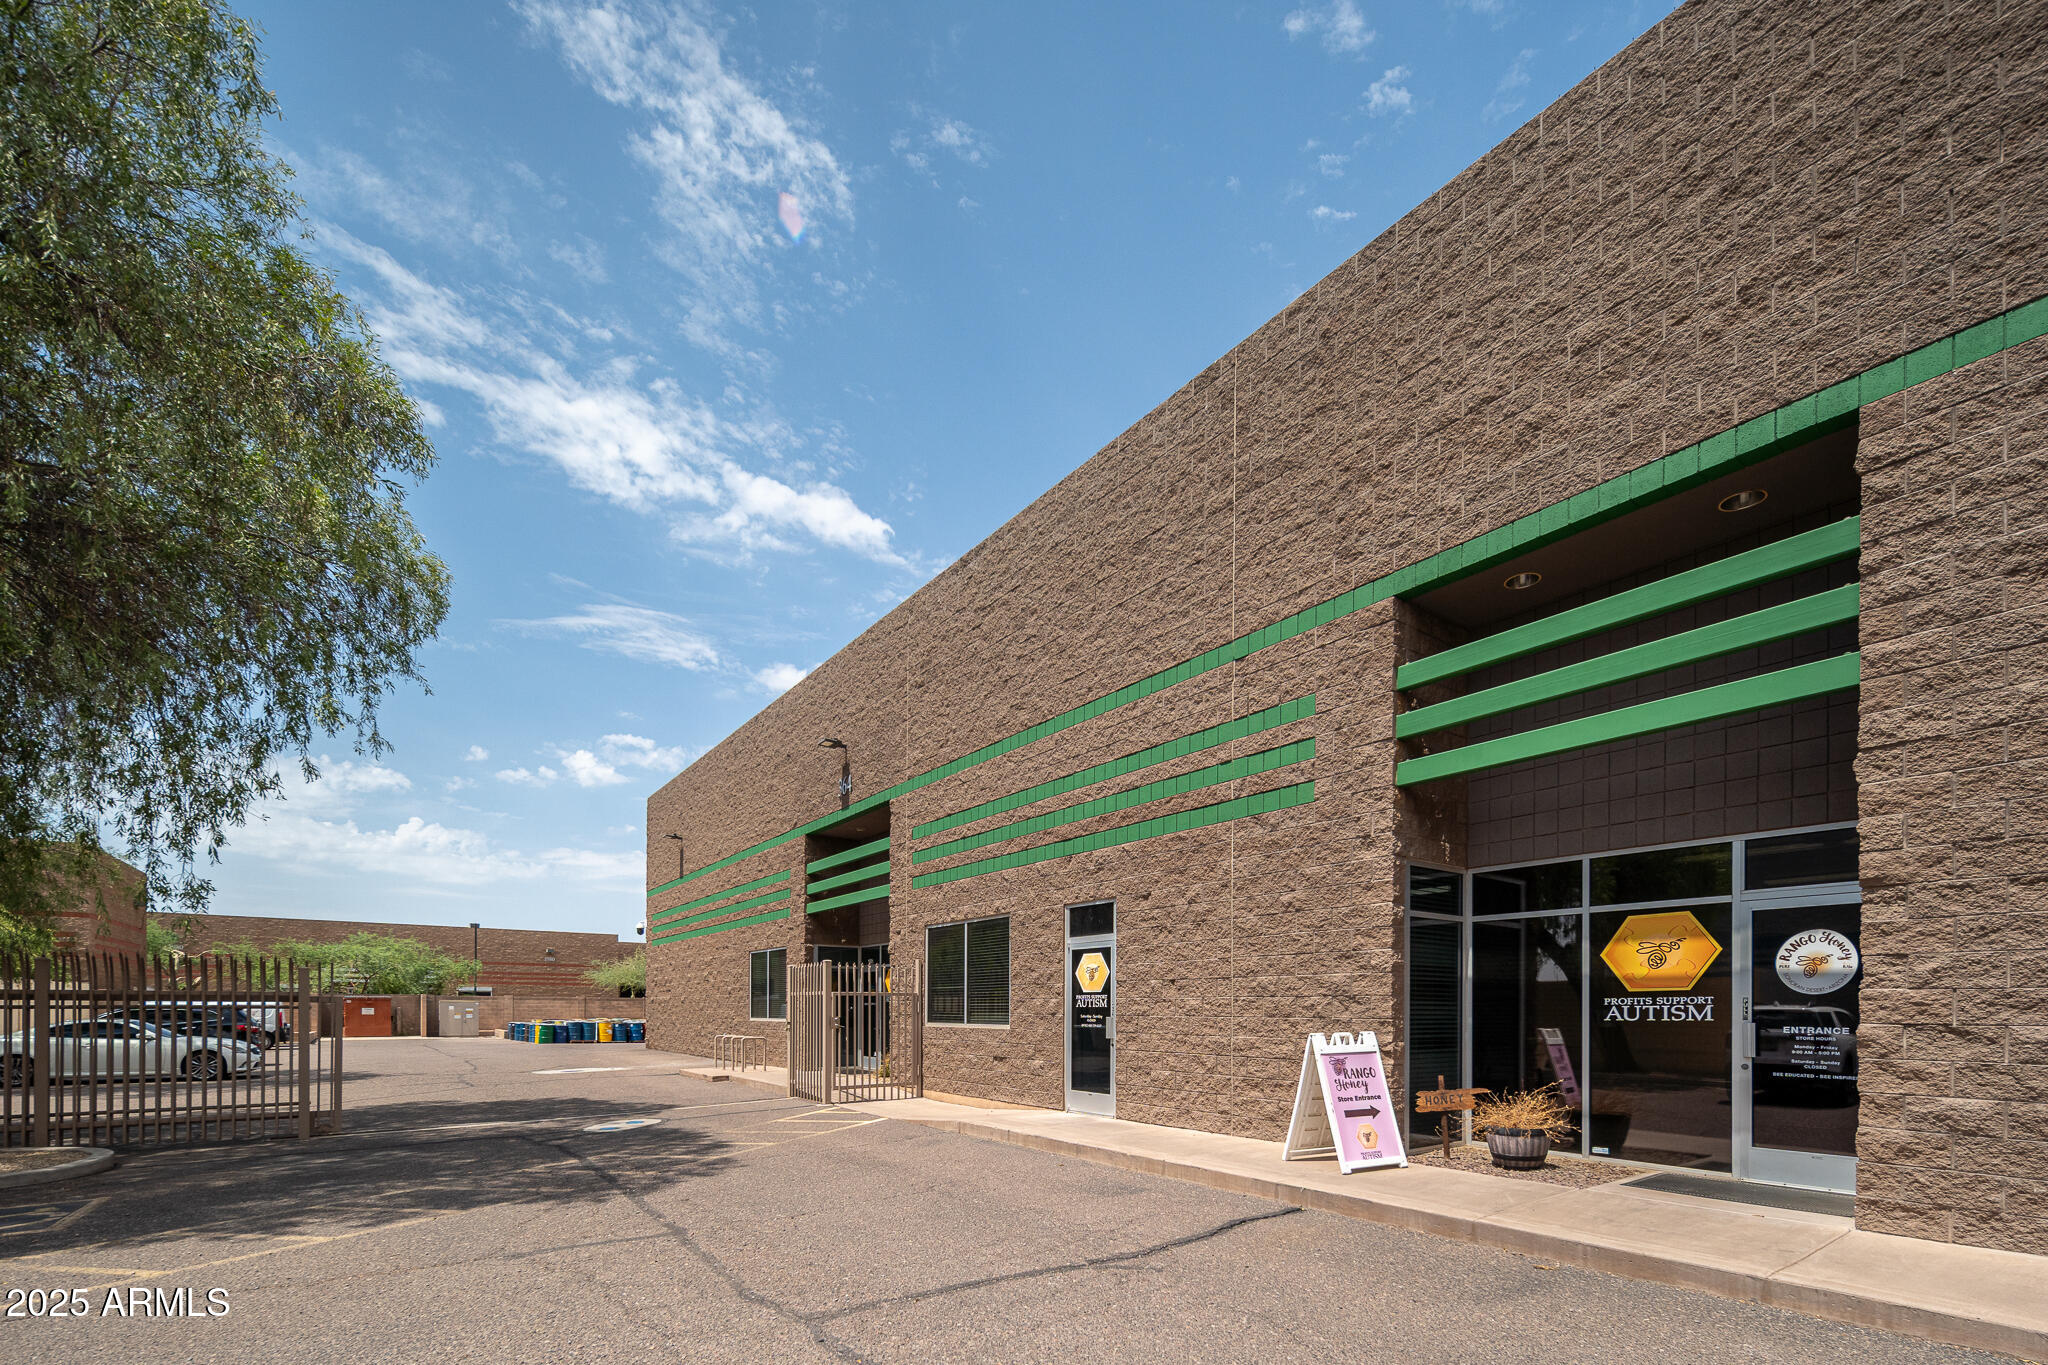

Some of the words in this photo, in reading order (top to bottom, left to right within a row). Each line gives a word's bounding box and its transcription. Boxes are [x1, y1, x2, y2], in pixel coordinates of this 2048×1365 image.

[1779, 934, 1817, 962] RANGO
[1819, 931, 1853, 961] Honey
[1076, 999, 1107, 1007] AUTISM
[1604, 997, 1653, 1006] PROFITS
[1656, 996, 1714, 1004] SUPPORT
[1604, 1004, 1714, 1022] AUTISM
[1783, 1026, 1850, 1035] ENTRANCE
[1343, 1066, 1377, 1080] RANGO
[1334, 1078, 1369, 1094] Honey
[1425, 1093, 1464, 1106] HONEY
